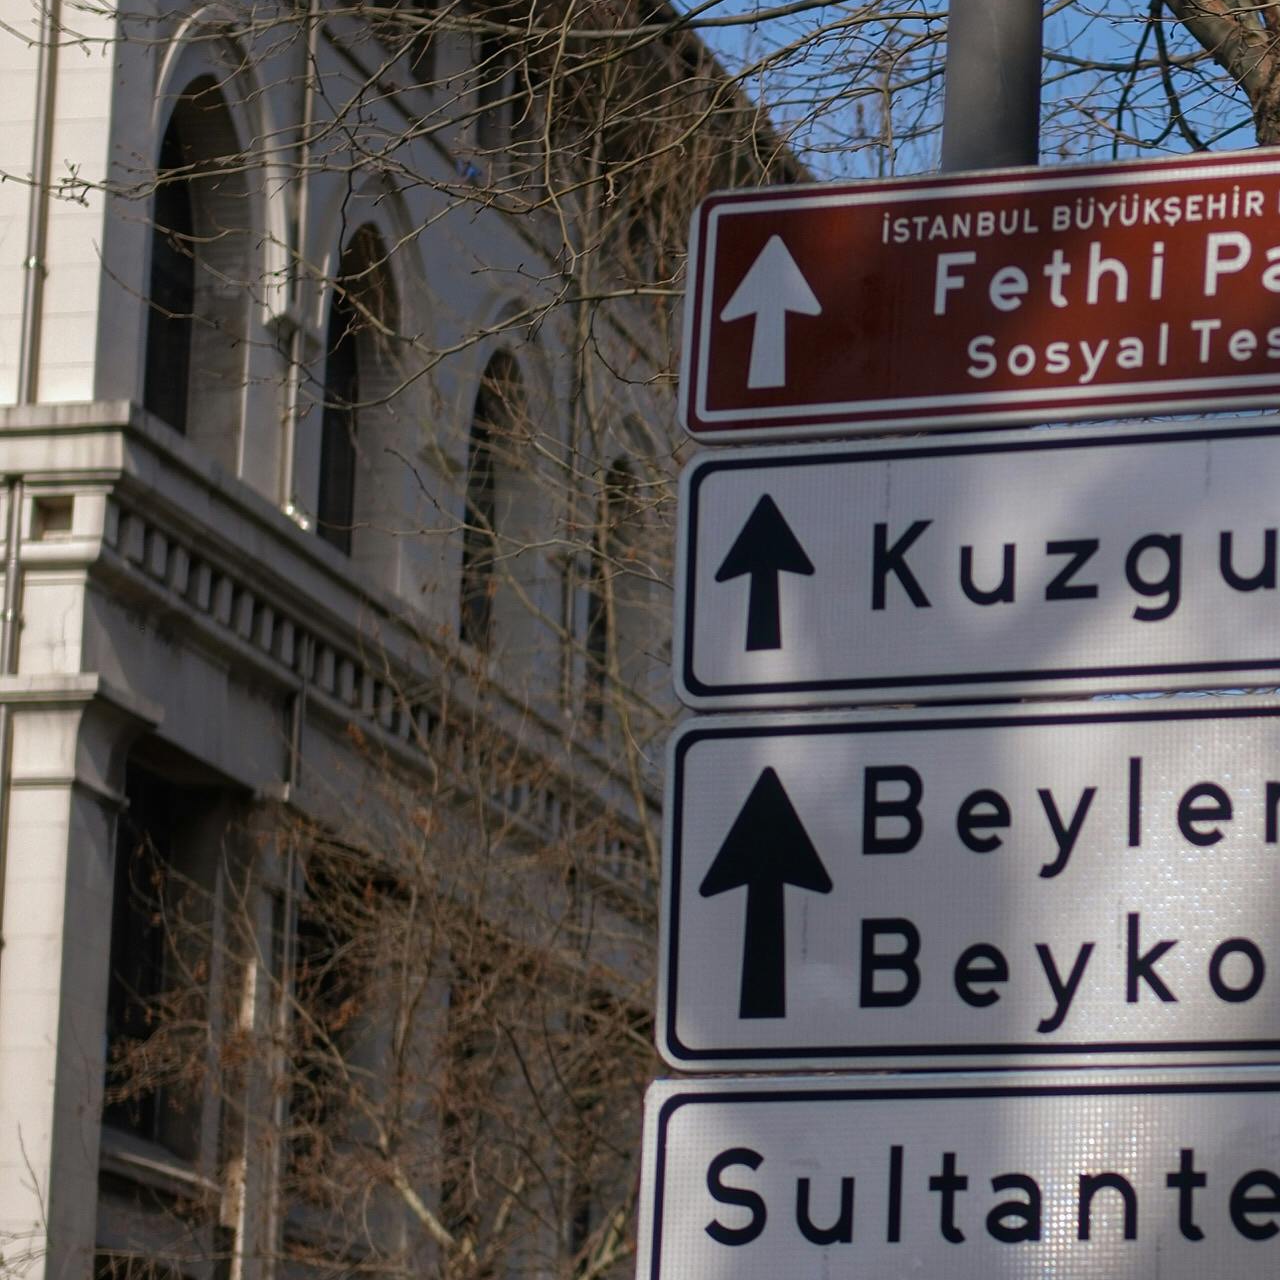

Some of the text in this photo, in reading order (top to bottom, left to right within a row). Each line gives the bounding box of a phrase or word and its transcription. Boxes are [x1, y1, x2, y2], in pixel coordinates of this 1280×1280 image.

[882, 211, 1039, 244] İSTANBUL
[1053, 185, 1265, 231] BÜYÜKŞEHİR
[934, 240, 1165, 315] Fethi
[967, 322, 1168, 383] Sosyal
